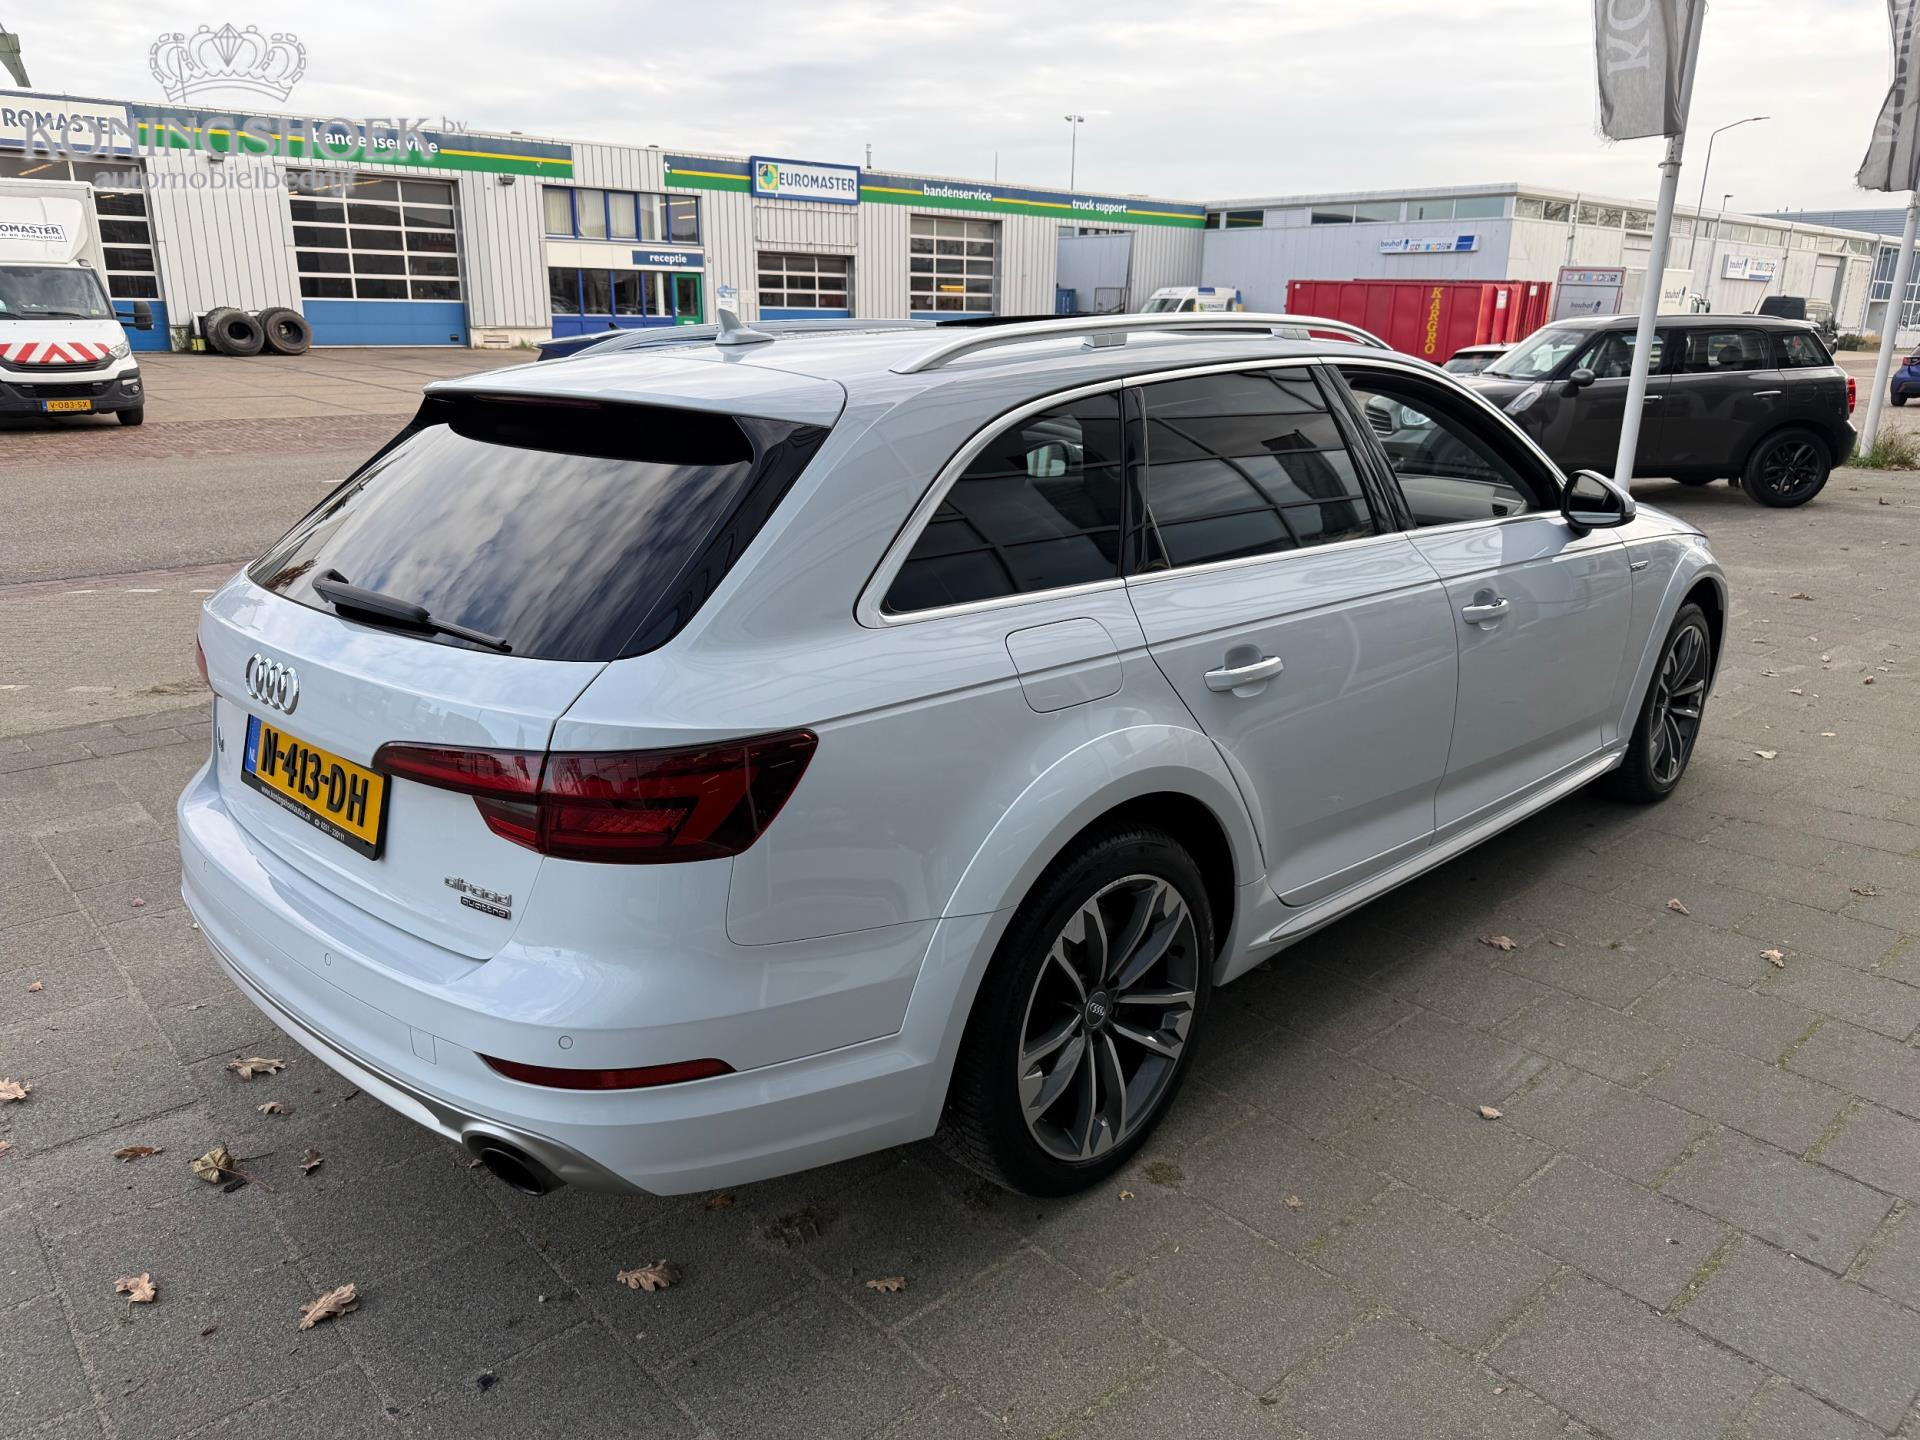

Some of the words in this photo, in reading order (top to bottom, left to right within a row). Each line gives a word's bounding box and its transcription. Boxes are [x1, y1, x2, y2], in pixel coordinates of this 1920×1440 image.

[779, 172, 855, 192] EUROMASTER
[923, 183, 992, 201] bandenservice
[1072, 199, 1095, 210] truck
[1095, 202, 1127, 215] support
[649, 254, 688, 265] receptie
[1423, 287, 1443, 354] KARGRO
[261, 728, 369, 828] N-413-DH
[461, 897, 507, 919] quattro
